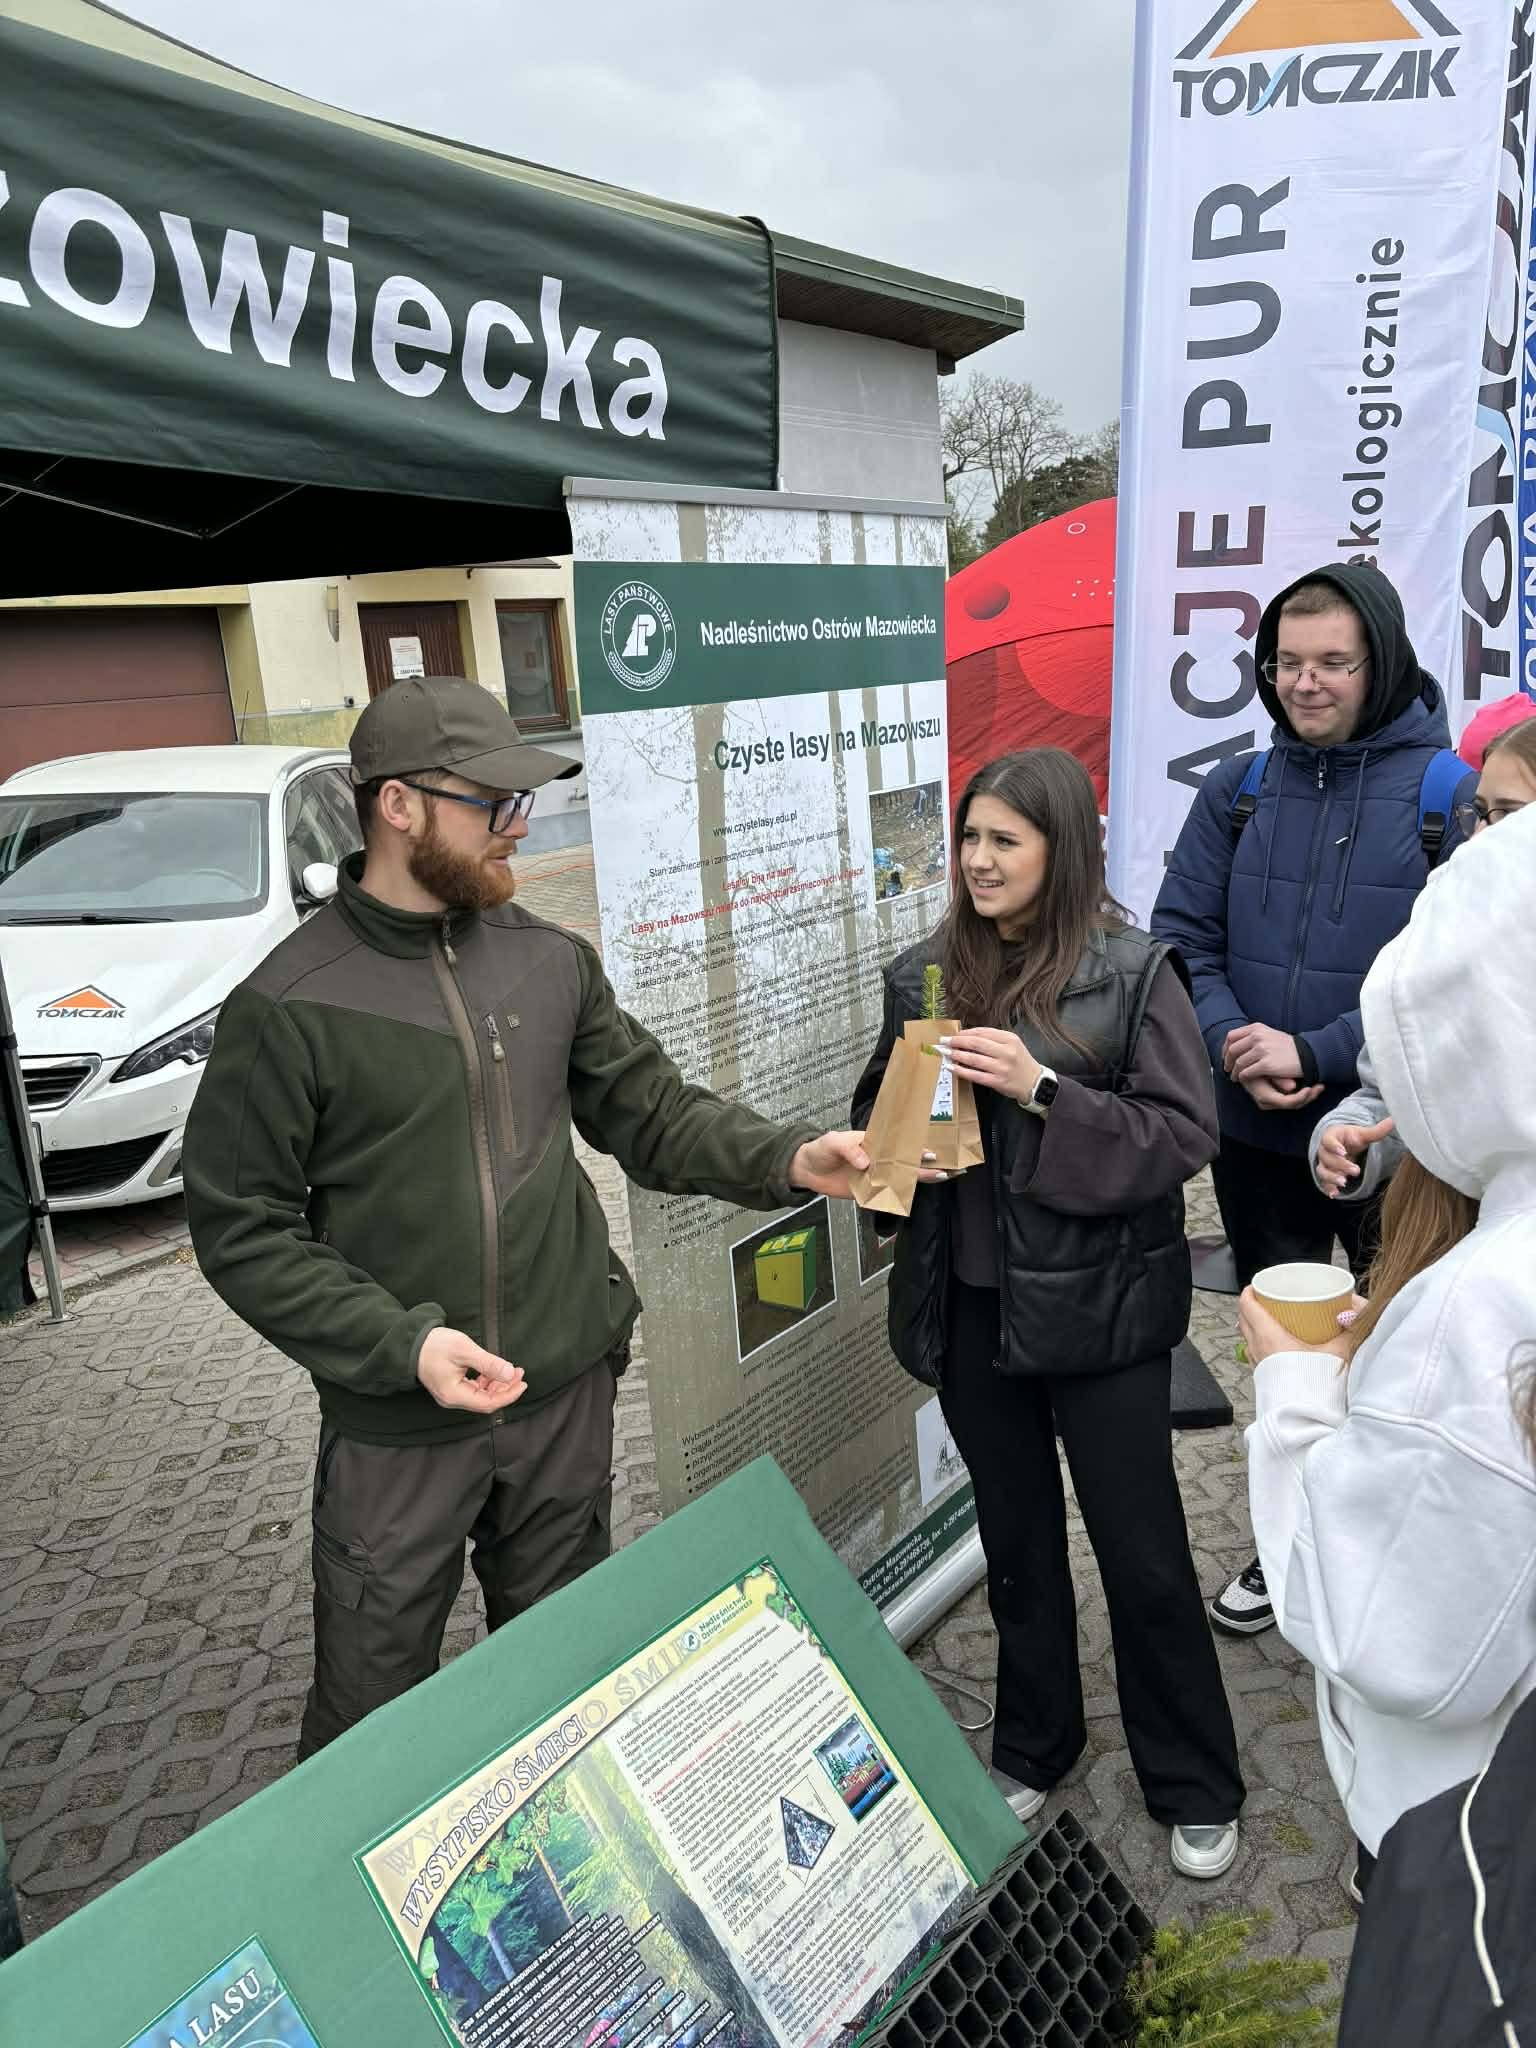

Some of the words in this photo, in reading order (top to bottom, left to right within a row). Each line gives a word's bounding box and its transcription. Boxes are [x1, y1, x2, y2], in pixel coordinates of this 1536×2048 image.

[1173, 47, 1463, 118] TOMCZAK
[0, 170, 669, 441] owiecka
[1181, 176, 1291, 450] PUR
[603, 598, 618, 635] LASY
[617, 583, 673, 633] PAŃSTWOWE
[700, 618, 808, 647] Nadleśnictwo
[812, 616, 861, 640] Ostrów
[865, 613, 936, 637] Mazowiecka
[714, 738, 785, 775] Czyste
[789, 729, 830, 762] lasy
[835, 731, 857, 754] na
[860, 716, 941, 747] Mazowszu
[712, 811, 798, 837] www.czystelasy.edu.pl
[631, 923, 654, 935] Lasy
[656, 917, 669, 928] na
[671, 908, 714, 925] Mazowszu
[739, 898, 749, 907] do
[36, 1008, 125, 1019] TOMCZAK
[399, 1775, 518, 1930] WYSYPISKO
[513, 1714, 585, 1794] ŚMIECI
[187, 1968, 263, 2046] LASU
